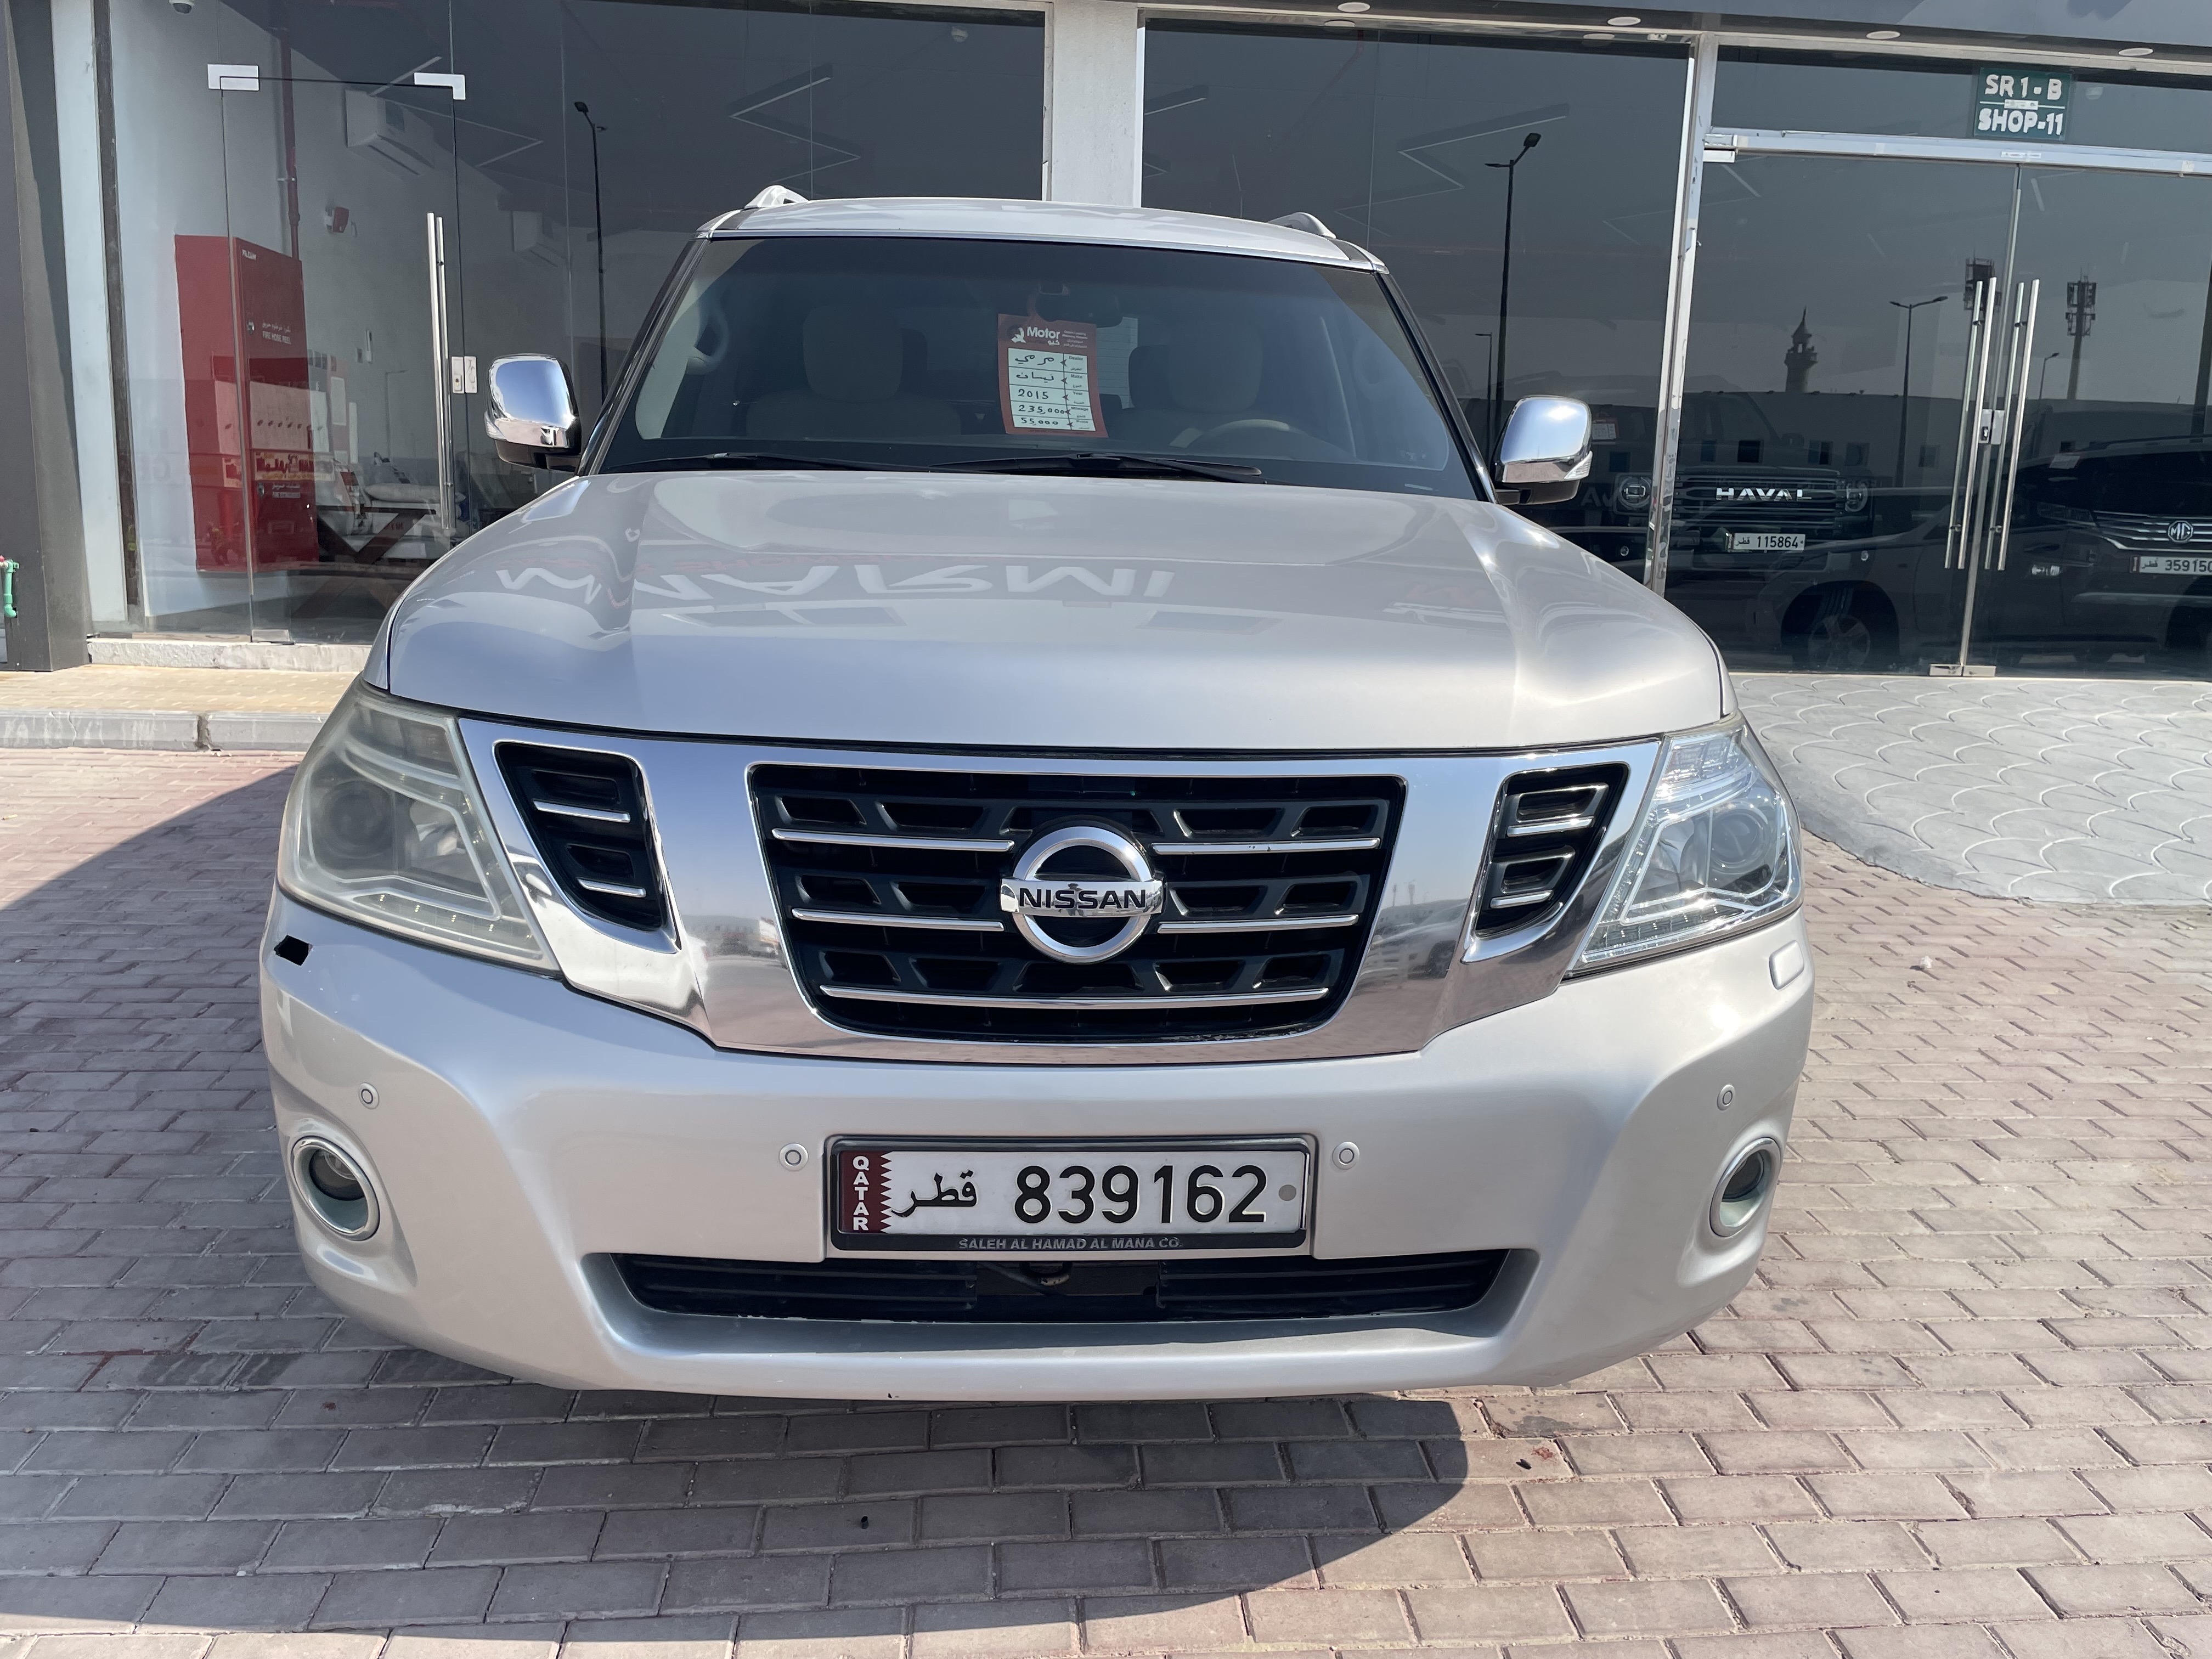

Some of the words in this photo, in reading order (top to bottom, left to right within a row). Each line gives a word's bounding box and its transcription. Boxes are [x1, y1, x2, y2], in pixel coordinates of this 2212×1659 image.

[1984, 74, 2015, 97] SR
[2021, 77, 2029, 98] 1
[2047, 78, 2062, 100] B
[1977, 108, 2063, 135] SHOP-11
[1026, 326, 1060, 340] Motor
[1018, 388, 1049, 399] 2015
[1018, 404, 1064, 414] 235,000
[1020, 417, 1058, 426] 55,000
[1716, 487, 1812, 501] HAVAL
[2170, 522, 2191, 540] MG
[1735, 537, 1750, 546] قطر
[1757, 536, 1798, 548] 115864
[1019, 887, 1147, 910] NISSAN
[852, 1155, 870, 1231] QATAR
[890, 1169, 977, 1218] قطر
[1014, 1165, 1266, 1224] 839162
[958, 1238, 1007, 1249] SALEH
[1010, 1238, 1028, 1249] AL
[1031, 1238, 1087, 1250] HAMAD
[1090, 1238, 1108, 1249] AL
[1111, 1237, 1155, 1249] MANA
[1159, 1237, 1182, 1248] CO.
